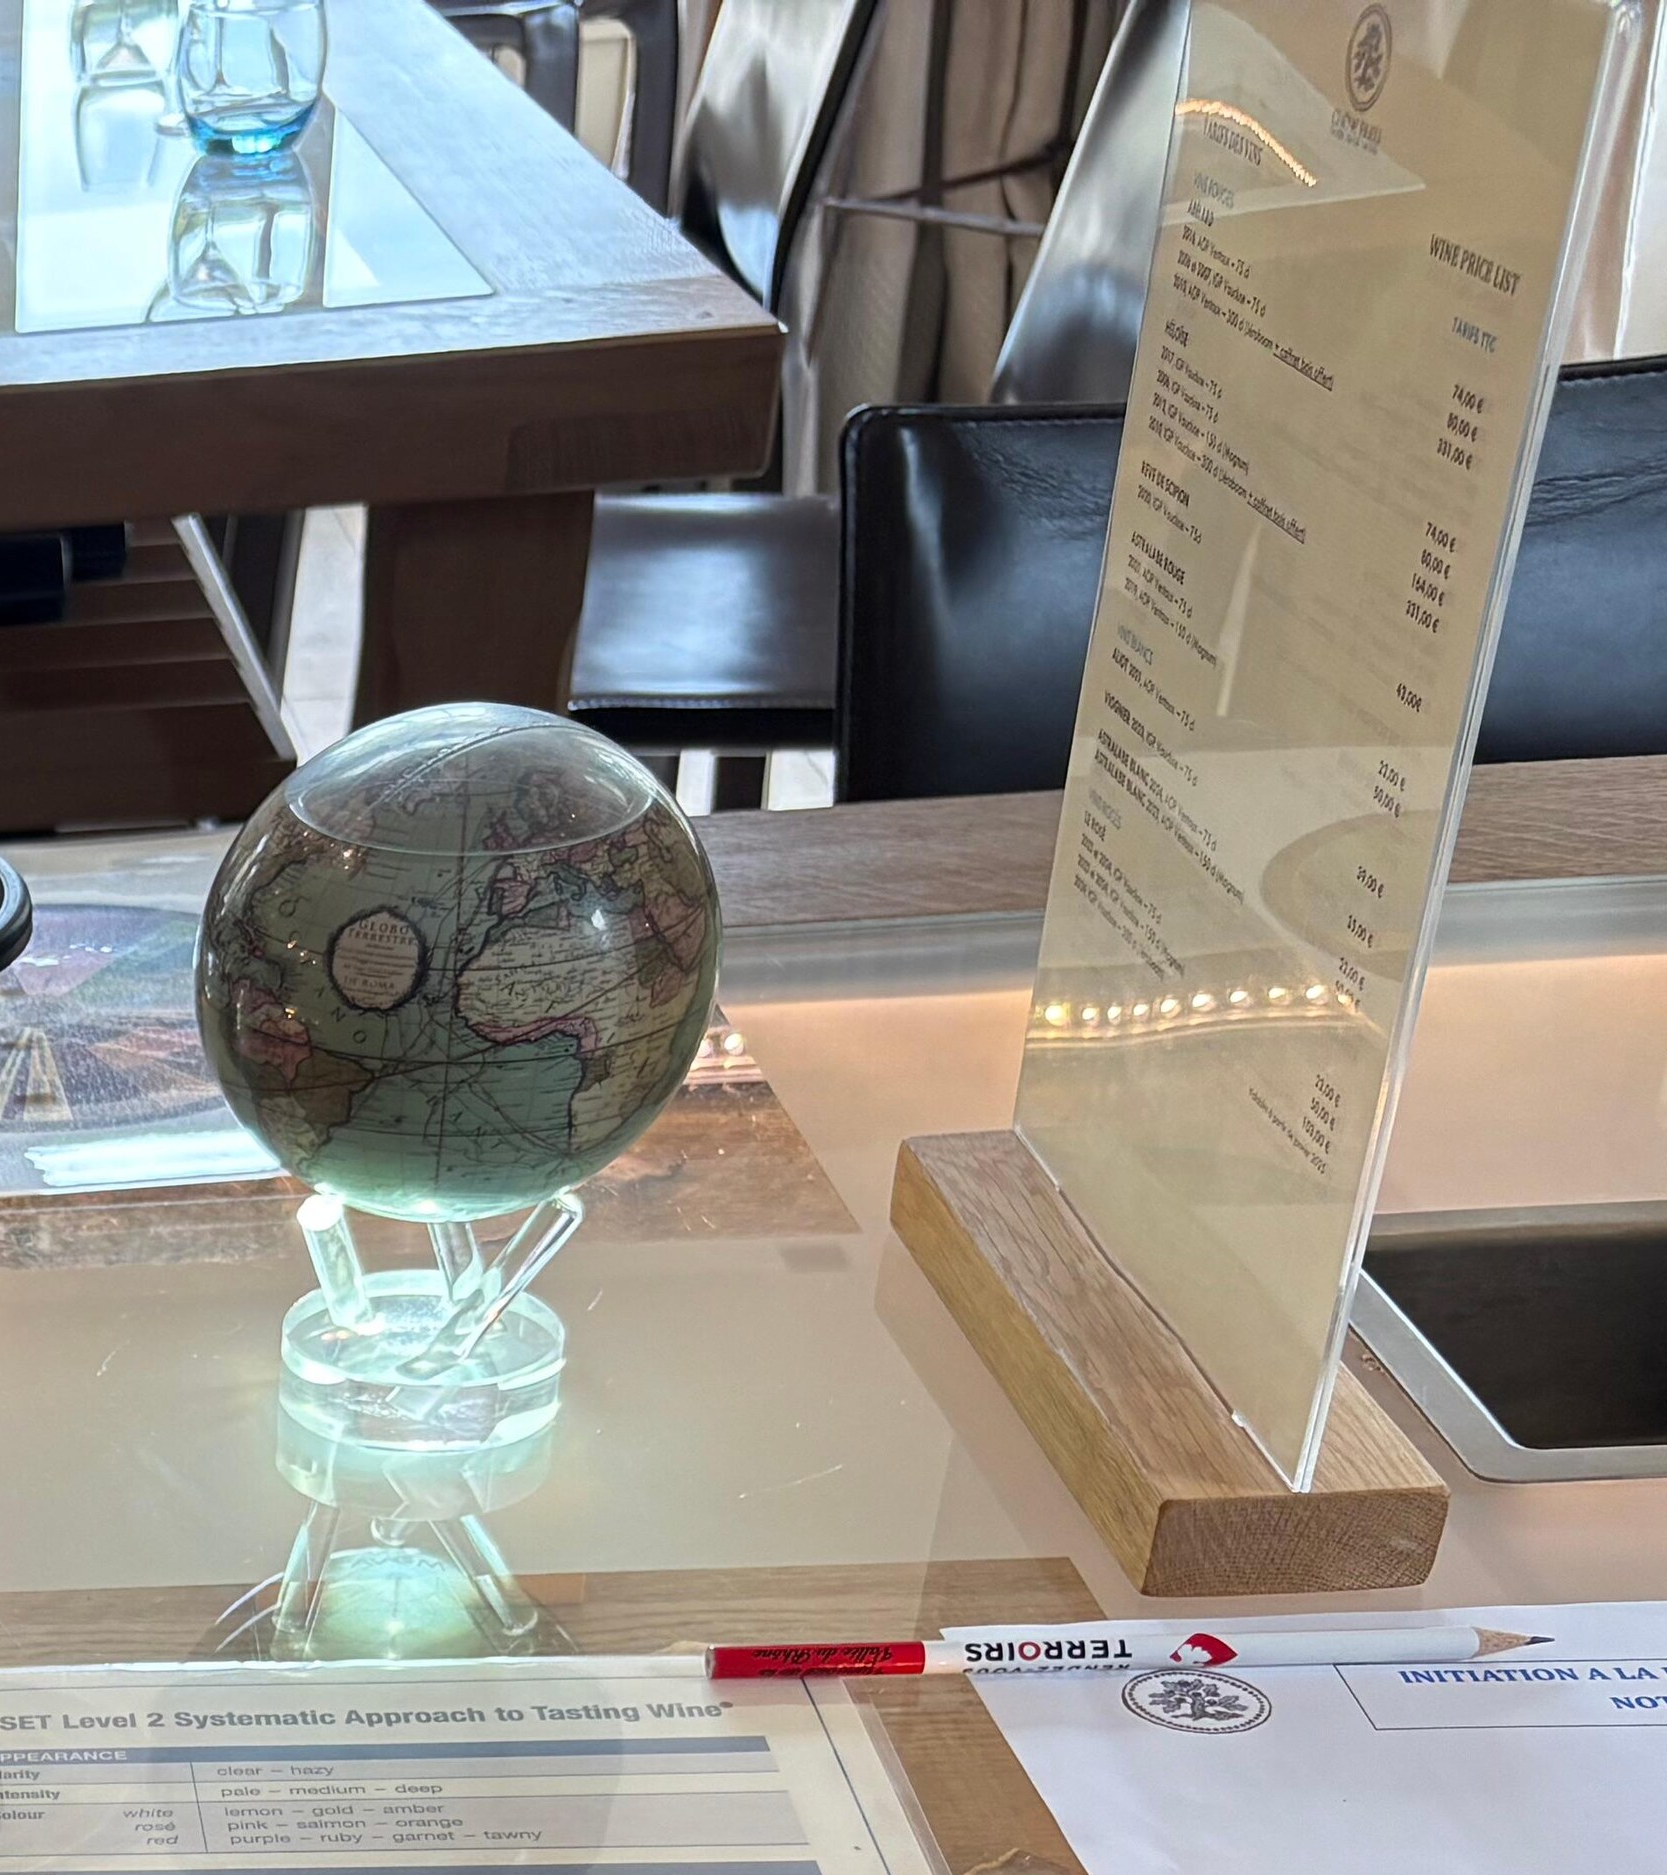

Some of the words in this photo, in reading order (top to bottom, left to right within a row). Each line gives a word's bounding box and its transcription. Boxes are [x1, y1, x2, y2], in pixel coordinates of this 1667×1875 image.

[1430, 233, 1459, 268] WINE
[1460, 249, 1494, 285] PRICE
[1492, 263, 1520, 296] LIST
[822, 1647, 841, 1661] du
[965, 1639, 1133, 1661] TERROIRS
[1399, 1667, 1579, 1684] INITIATION
[1588, 1667, 1610, 1681] A
[1614, 1667, 1657, 1680] LA
[61, 1711, 137, 1729] Level
[146, 1711, 165, 1728] 2
[173, 1709, 336, 1730] Systematic
[345, 1705, 485, 1730] Approach
[494, 1706, 524, 1722] to
[531, 1702, 641, 1725] Tasting
[217, 1765, 263, 1778] clear
[290, 1764, 335, 1778] hazy
[221, 1785, 261, 1799] pale
[289, 1783, 366, 1796] medium
[395, 1782, 443, 1796] deep
[123, 1808, 173, 1820] white
[224, 1806, 284, 1819] lemon
[313, 1804, 354, 1818] gold
[383, 1803, 444, 1815] amber
[135, 1820, 176, 1833] rosé
[227, 1819, 268, 1832] pink
[296, 1817, 366, 1829] salmon
[396, 1816, 463, 1830] orange
[146, 1834, 178, 1846] red
[229, 1833, 292, 1848] purple
[321, 1832, 363, 1845] ruby
[392, 1830, 455, 1845] garnet
[484, 1829, 542, 1842] tawny
